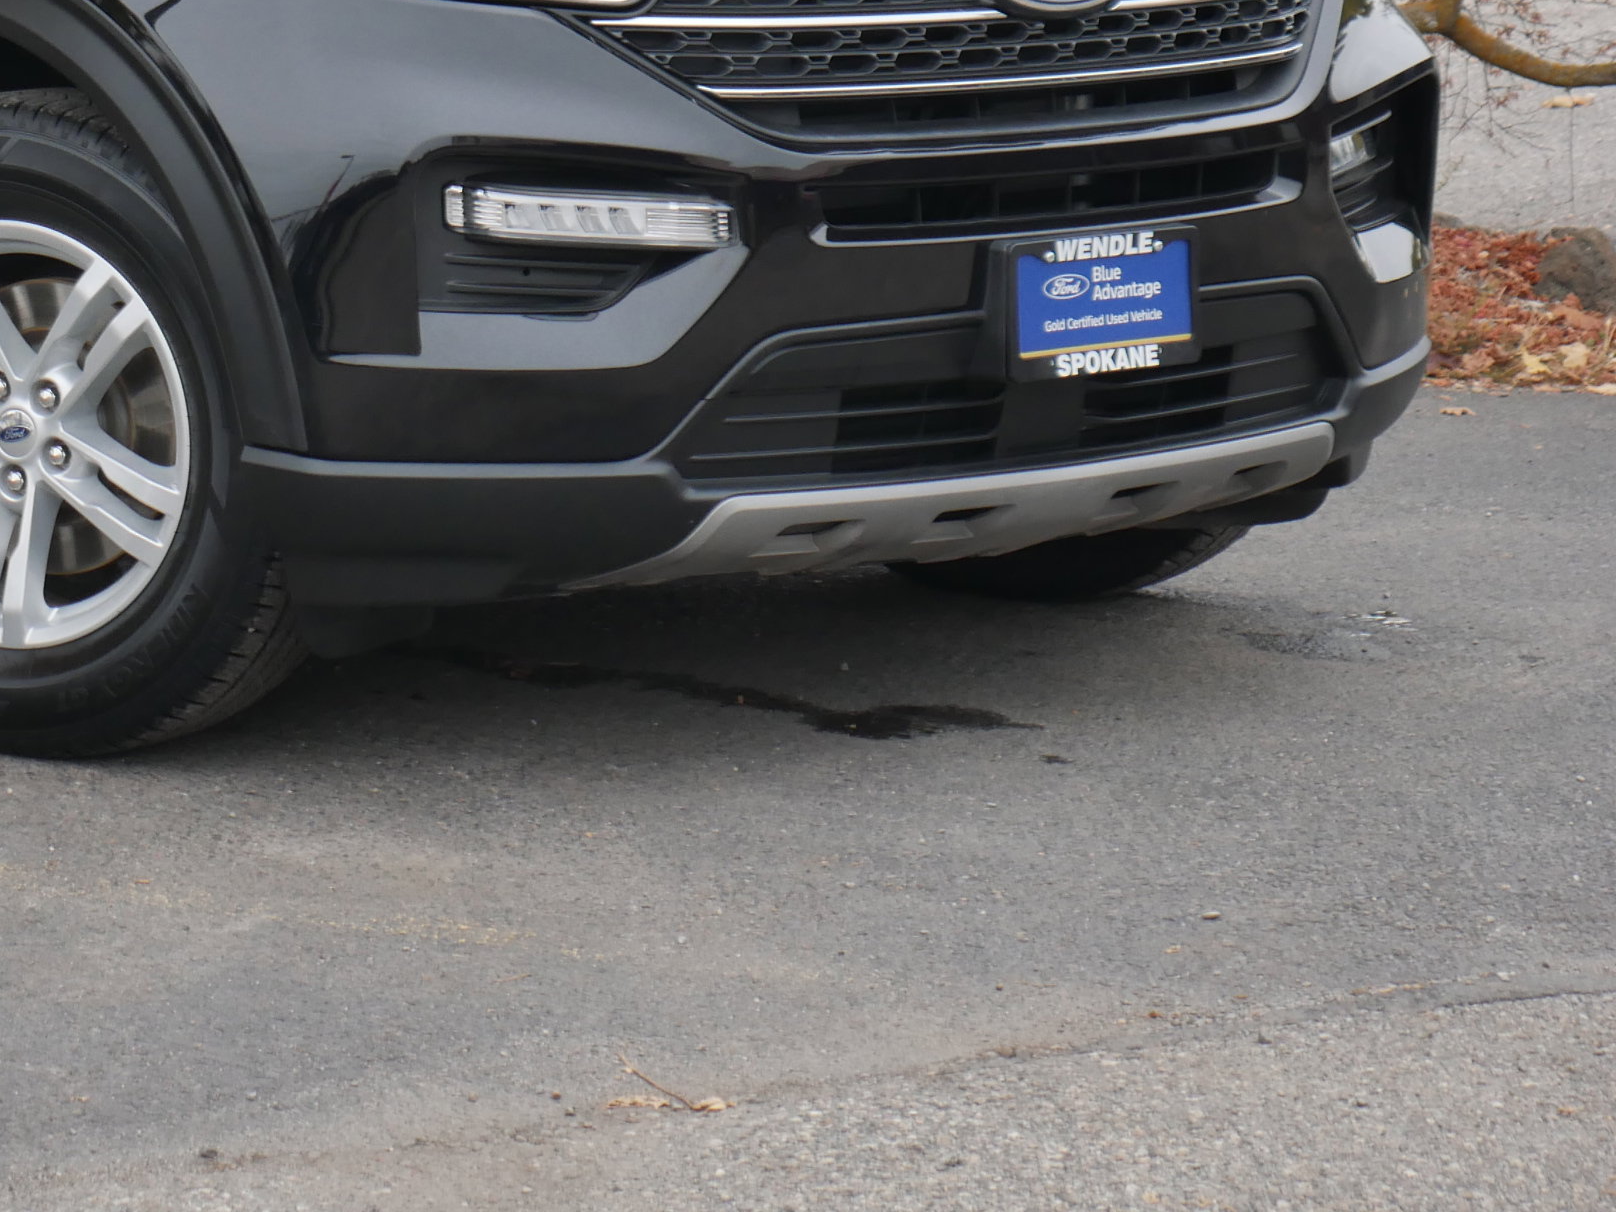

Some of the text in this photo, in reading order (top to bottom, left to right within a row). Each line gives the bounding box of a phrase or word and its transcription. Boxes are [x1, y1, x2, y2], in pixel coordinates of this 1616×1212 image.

[1055, 231, 1155, 263] WENDLE
[1092, 265, 1122, 282] Blue
[1051, 277, 1081, 296] Ford
[1092, 281, 1162, 301] Advantage
[1044, 308, 1163, 333] Gold Certified Used Vehicle
[1056, 344, 1160, 378] SPOKANE
